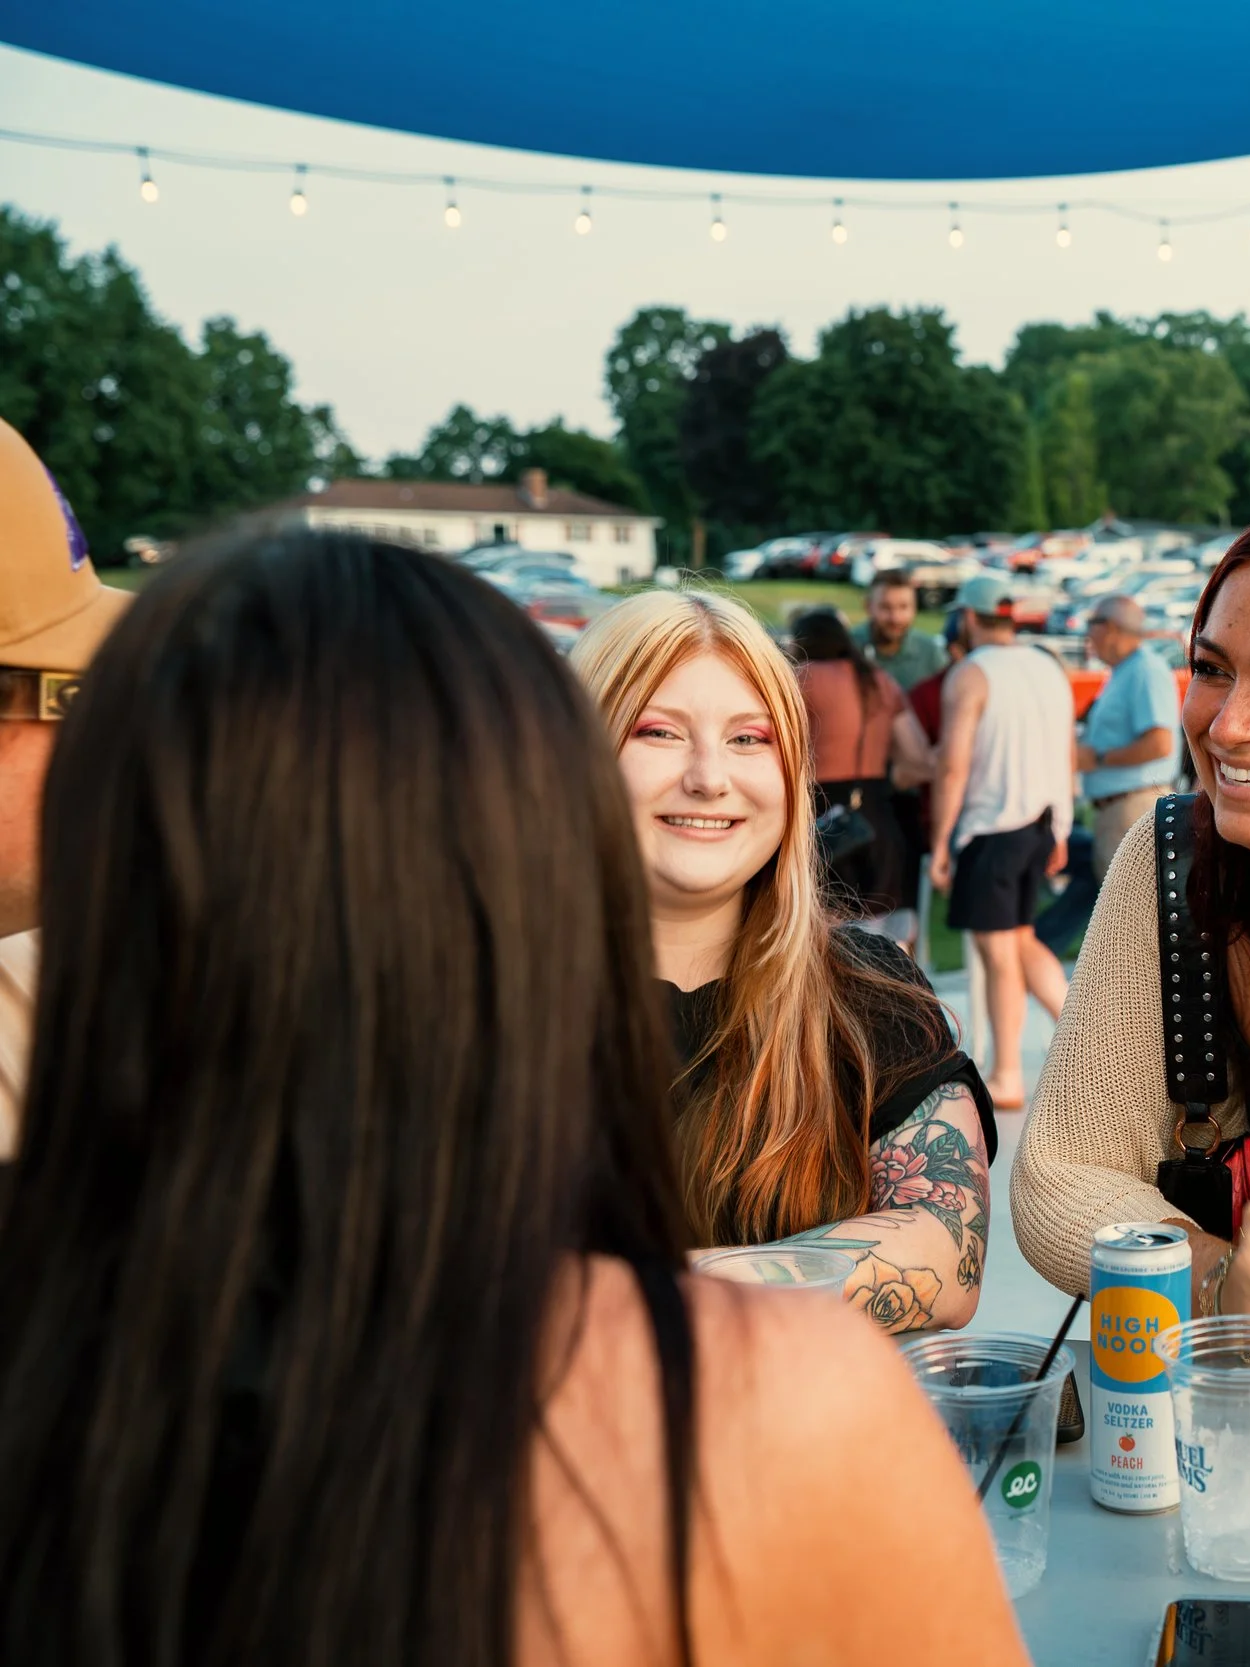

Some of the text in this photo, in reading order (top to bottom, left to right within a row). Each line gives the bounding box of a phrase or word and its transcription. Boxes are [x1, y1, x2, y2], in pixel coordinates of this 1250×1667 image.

[1101, 1312, 1159, 1333] HIGH
[1107, 1402, 1148, 1416] VODKA
[1104, 1414, 1154, 1429] SELTZER
[1111, 1455, 1144, 1470] PEACH
